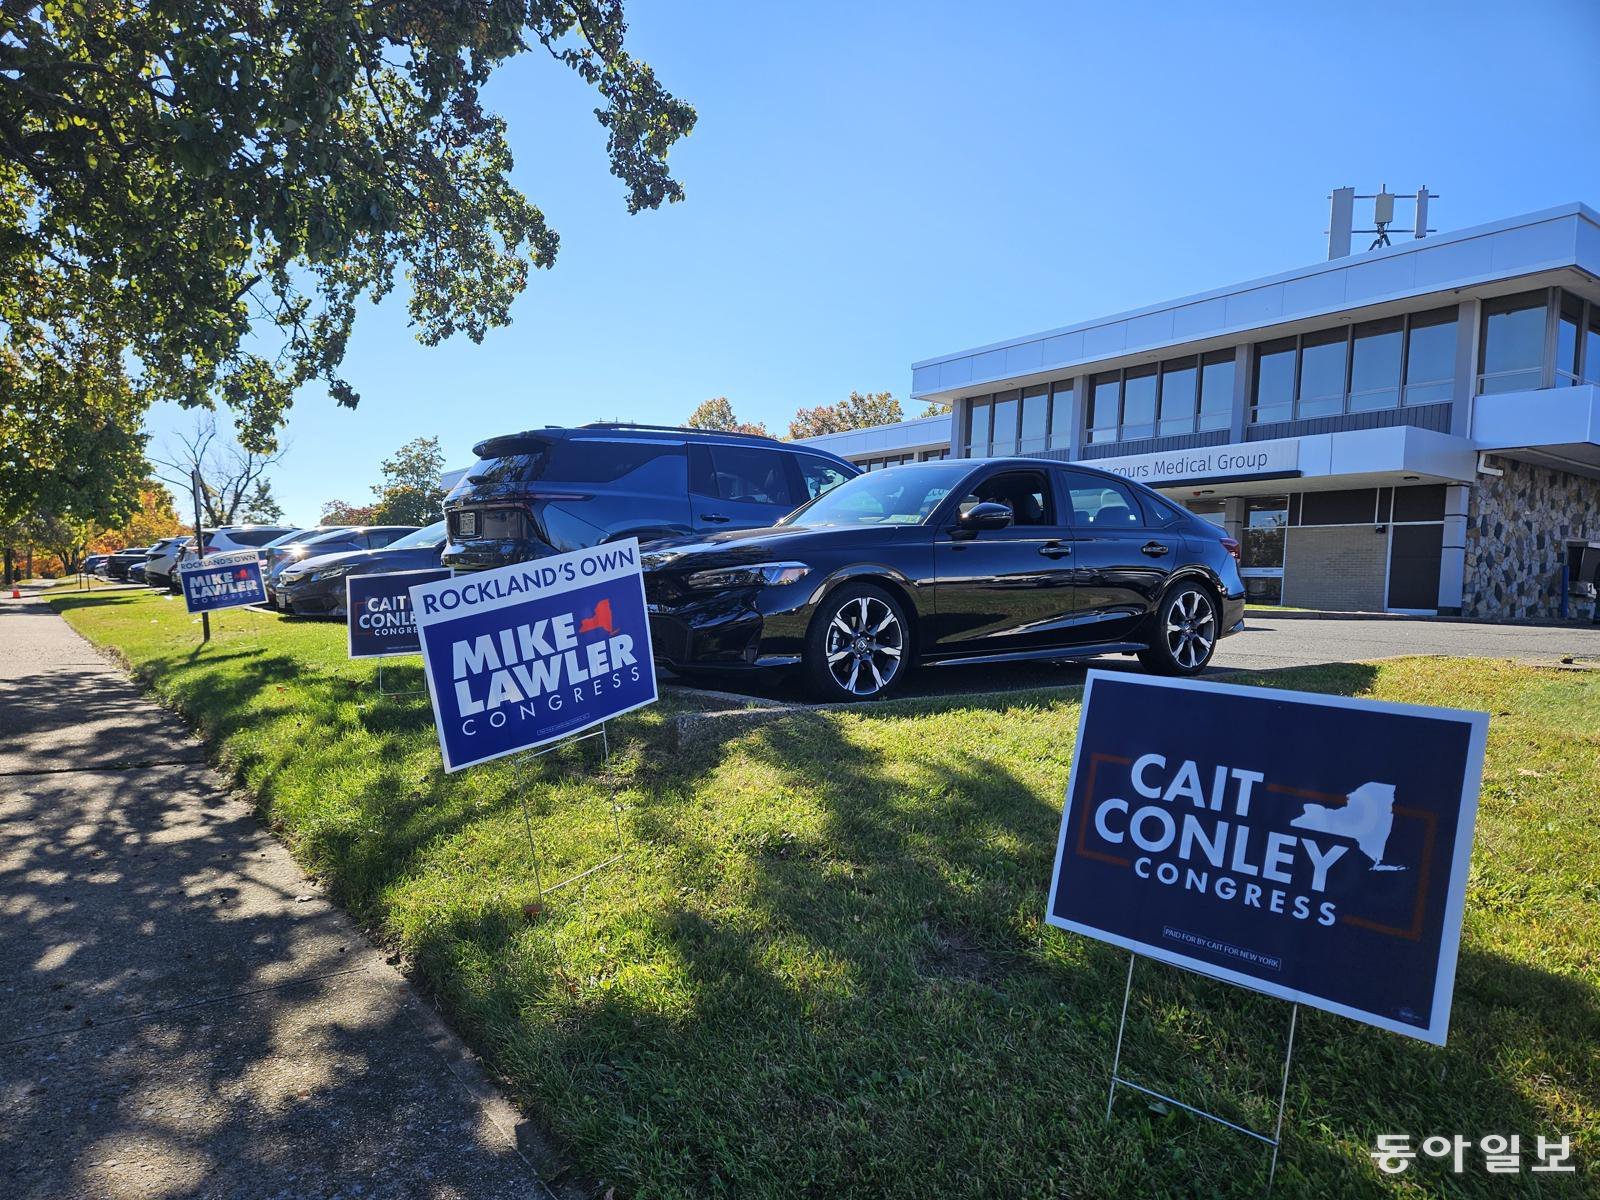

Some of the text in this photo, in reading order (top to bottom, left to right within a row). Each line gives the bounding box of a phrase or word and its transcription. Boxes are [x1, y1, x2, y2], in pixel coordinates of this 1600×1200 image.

[1099, 451, 1268, 478] cours Medical Group
[181, 554, 256, 570] ROCKLAND'S OWN
[189, 572, 233, 588] MIKE
[422, 548, 634, 614] ROCKLAND'S OWN
[190, 580, 258, 599] LAWLER
[367, 595, 407, 612] CAIT
[359, 611, 417, 629] CONLE
[374, 626, 418, 636] CONGRE
[452, 612, 578, 680] MIKE
[454, 634, 638, 718] LAWLER
[462, 667, 640, 736] CONGRESS
[1131, 753, 1264, 817] CAIT
[1094, 798, 1349, 892] CONLEY
[1134, 857, 1336, 927] CONGRESS
[1165, 928, 1278, 968] PAID FOR BY CAIT FOR NEW YORK
